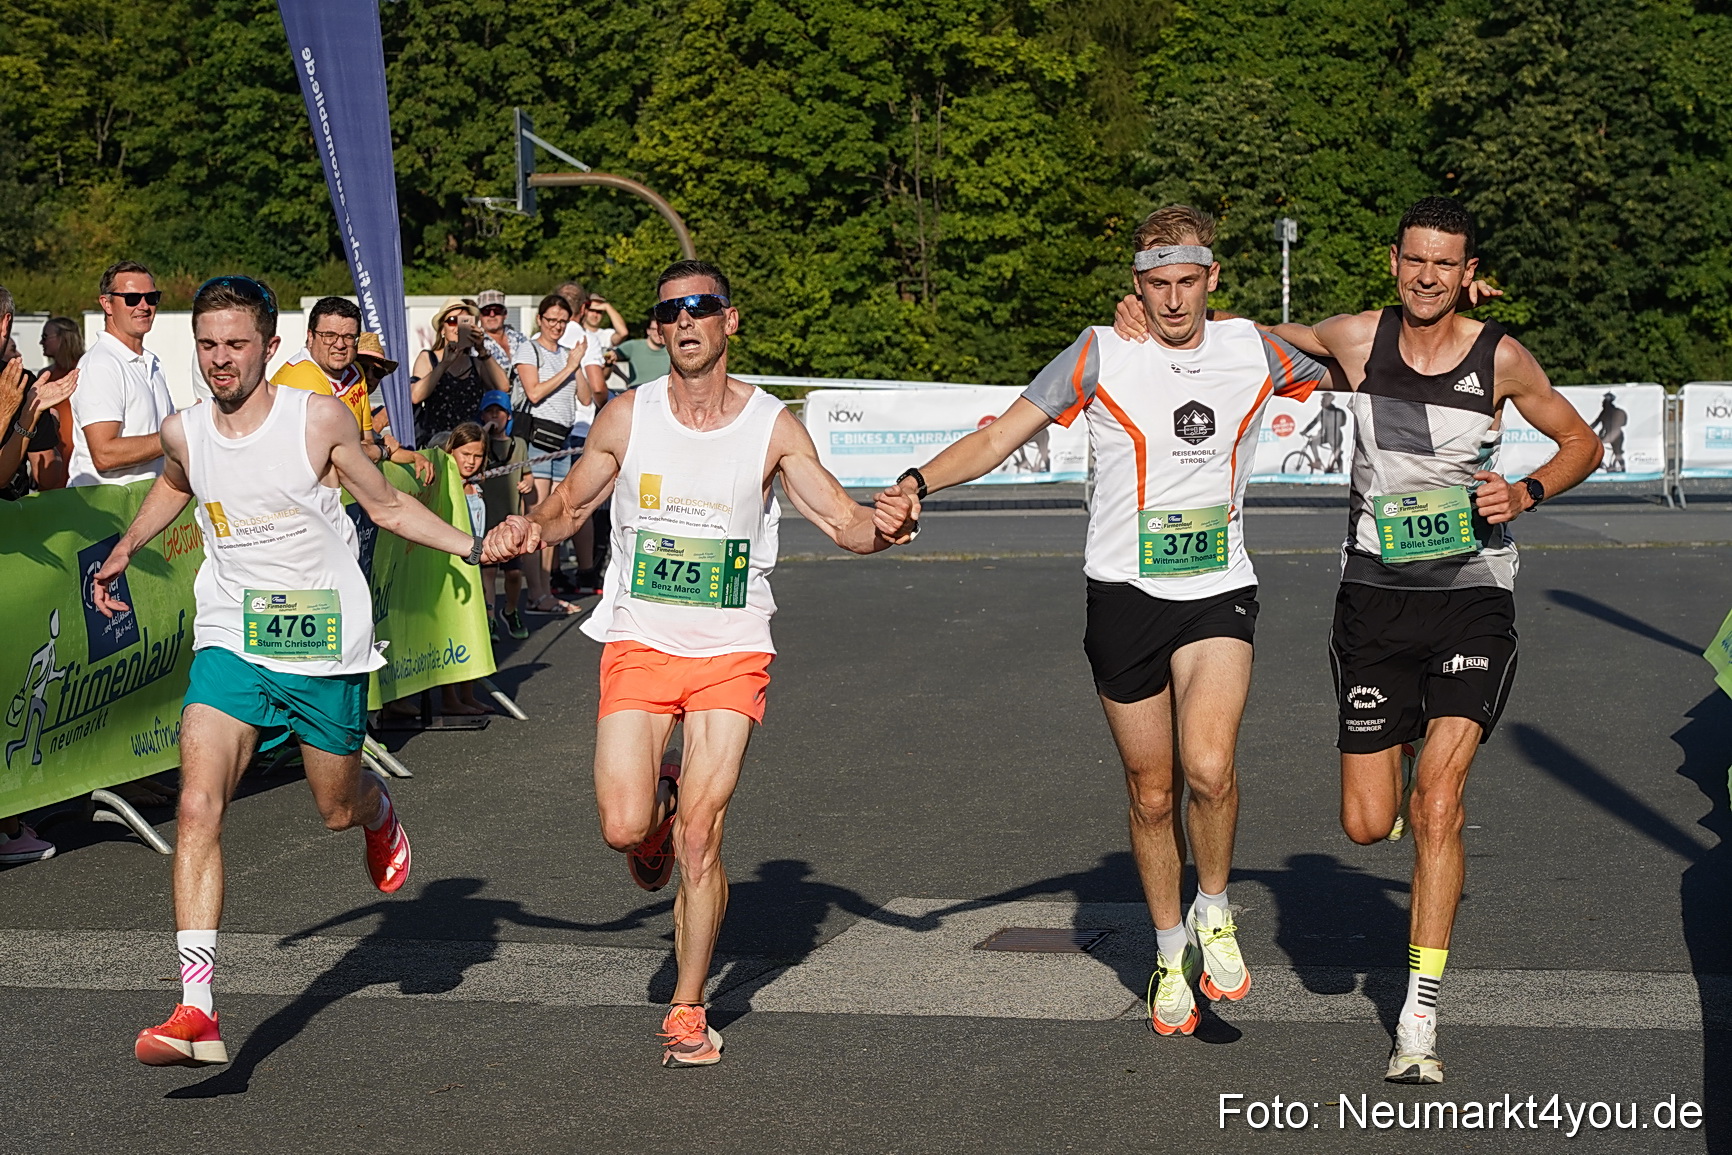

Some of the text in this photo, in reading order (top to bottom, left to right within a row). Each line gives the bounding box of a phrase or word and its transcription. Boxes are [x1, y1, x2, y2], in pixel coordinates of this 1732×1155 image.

[1454, 384, 1485, 397] adidas
[829, 410, 863, 422] NOW
[832, 432, 883, 444] E-BIKES
[886, 432, 896, 444] &
[1172, 449, 1216, 457] REISEMOBILE
[666, 505, 706, 516] MIEHLING
[667, 496, 732, 515] GOLDSCHMIEDE
[1400, 503, 1429, 512] Firmenlauf
[233, 507, 300, 528] GOLDSCHMIEDE
[236, 523, 275, 536] MIEHLING
[1163, 521, 1192, 529] Firmenlauf
[1402, 513, 1449, 538] 196
[1459, 512, 1470, 543] 2022
[1163, 531, 1208, 556] 378
[1384, 526, 1394, 550] RUN
[1400, 536, 1455, 549] Böllet Stefan
[657, 546, 685, 554] Firmenlauf
[1144, 541, 1153, 565] RUN
[1216, 531, 1225, 562] 2022
[1153, 553, 1217, 565] Wittmann Thomas
[636, 561, 647, 586] RUN
[653, 558, 701, 584] 475
[651, 580, 701, 594] Benz Marco
[709, 566, 720, 598] 2022
[267, 602, 298, 610] Firmenlauf
[266, 614, 316, 638] 476
[248, 622, 258, 646] RUN
[327, 617, 336, 650] 2022
[257, 638, 327, 648] Sturm Christoph
[56, 609, 186, 726] firmenlauf
[1466, 658, 1487, 667] RUN
[1353, 699, 1377, 709] Hirsch
[50, 708, 109, 755] neumarkt
[1348, 724, 1382, 732] FELDBERGER
